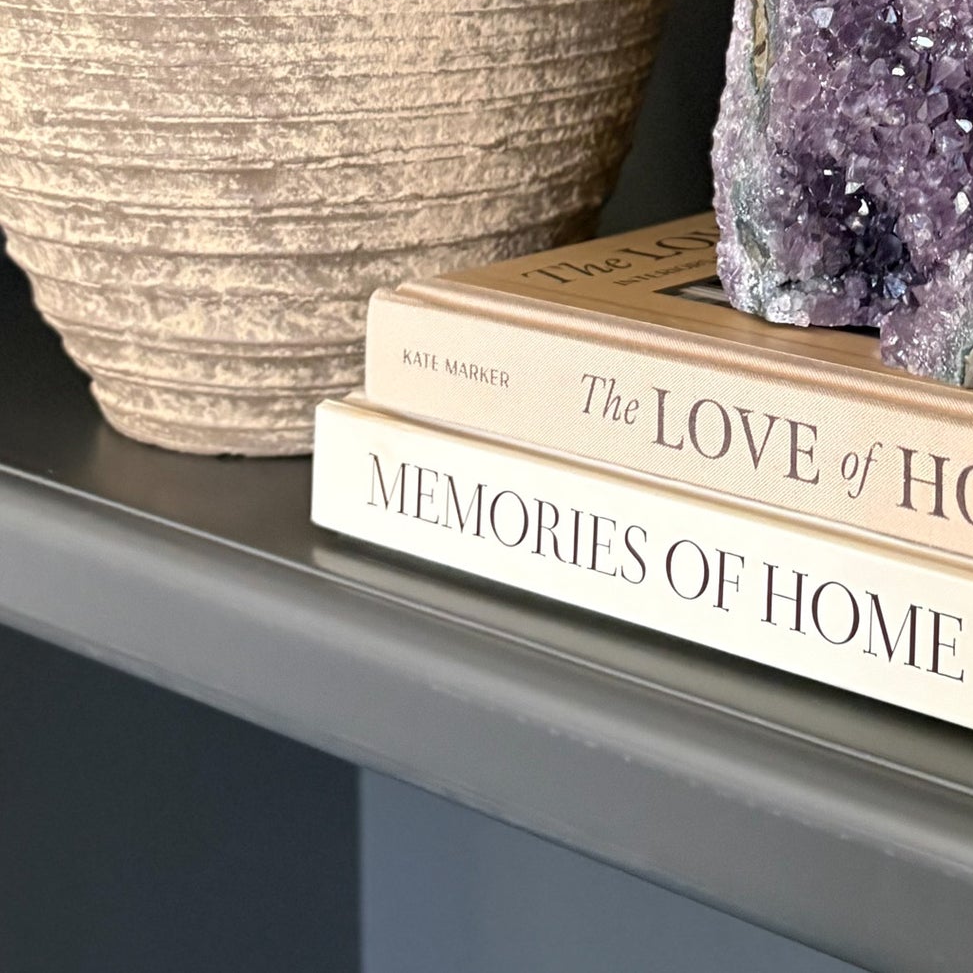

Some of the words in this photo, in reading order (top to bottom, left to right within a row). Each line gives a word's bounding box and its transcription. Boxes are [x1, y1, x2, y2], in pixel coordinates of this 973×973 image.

[521, 256, 632, 284] The
[620, 230, 719, 261] LO
[402, 348, 440, 372] KATE
[445, 358, 510, 388] MARKER
[581, 373, 640, 425] The
[652, 387, 820, 485] LOVE
[840, 442, 883, 499] of
[367, 452, 647, 584] MEMORIES
[665, 539, 745, 612] OF
[760, 561, 965, 683] HOME
